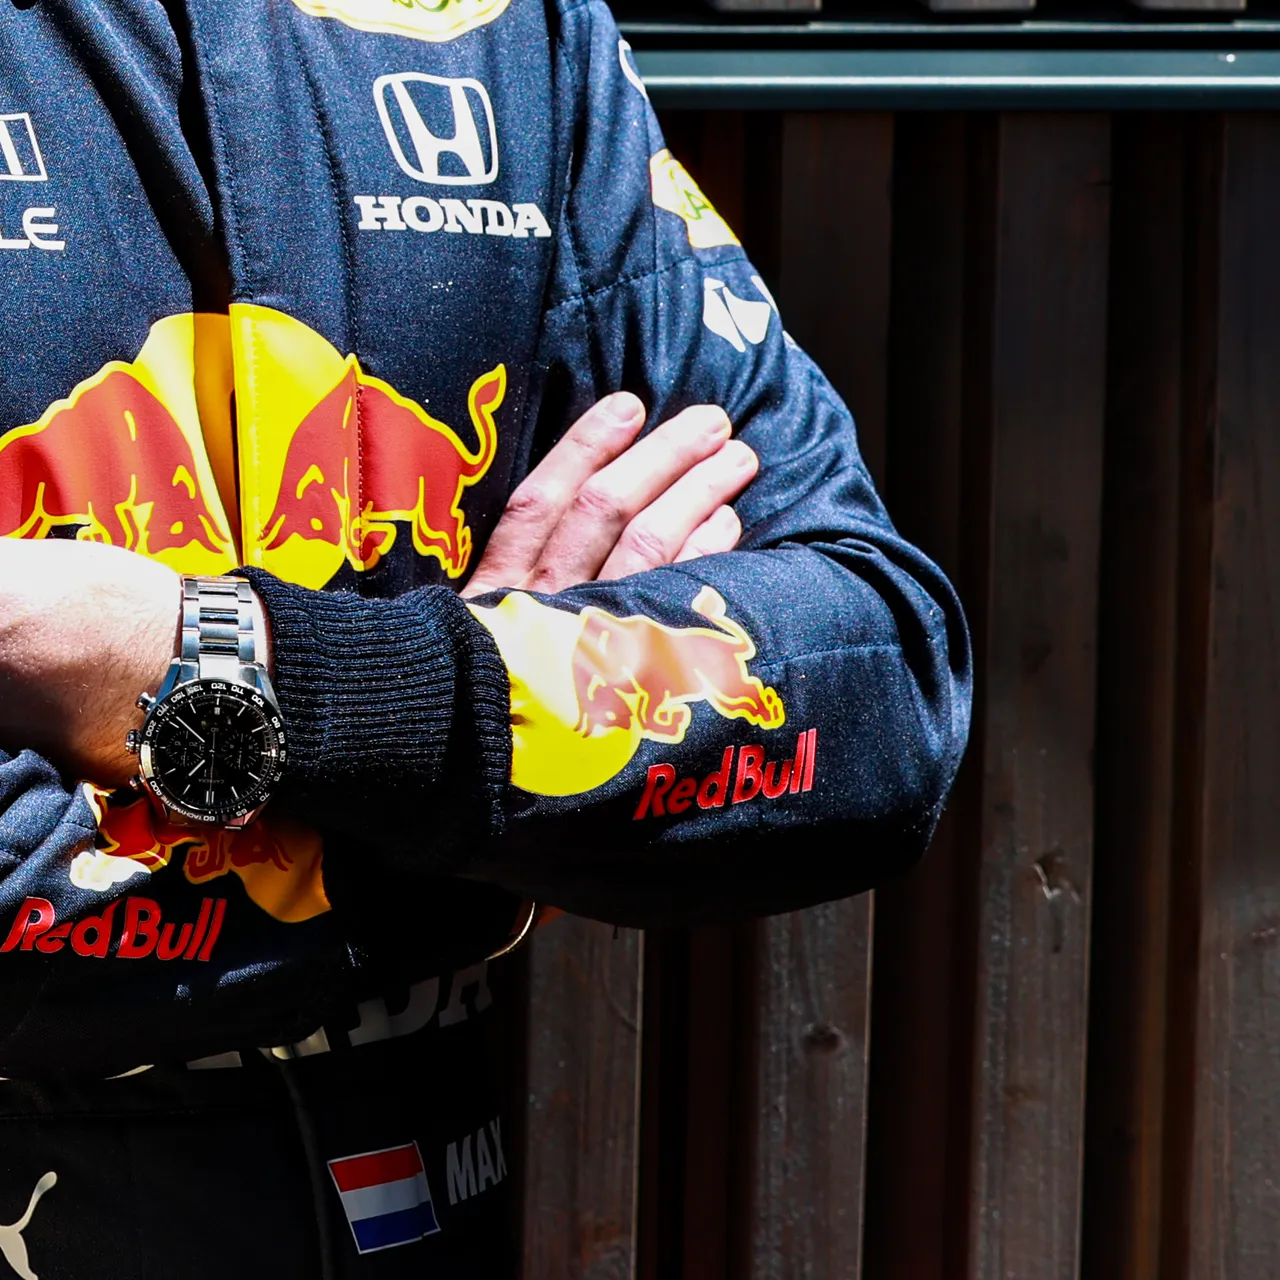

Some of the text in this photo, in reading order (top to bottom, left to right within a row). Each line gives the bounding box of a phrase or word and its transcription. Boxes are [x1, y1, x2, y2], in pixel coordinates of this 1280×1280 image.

[354, 195, 552, 239] HONDA
[633, 728, 817, 820] Red Bull
[0, 896, 227, 961] Red Bull
[446, 1117, 508, 1206] MAX
